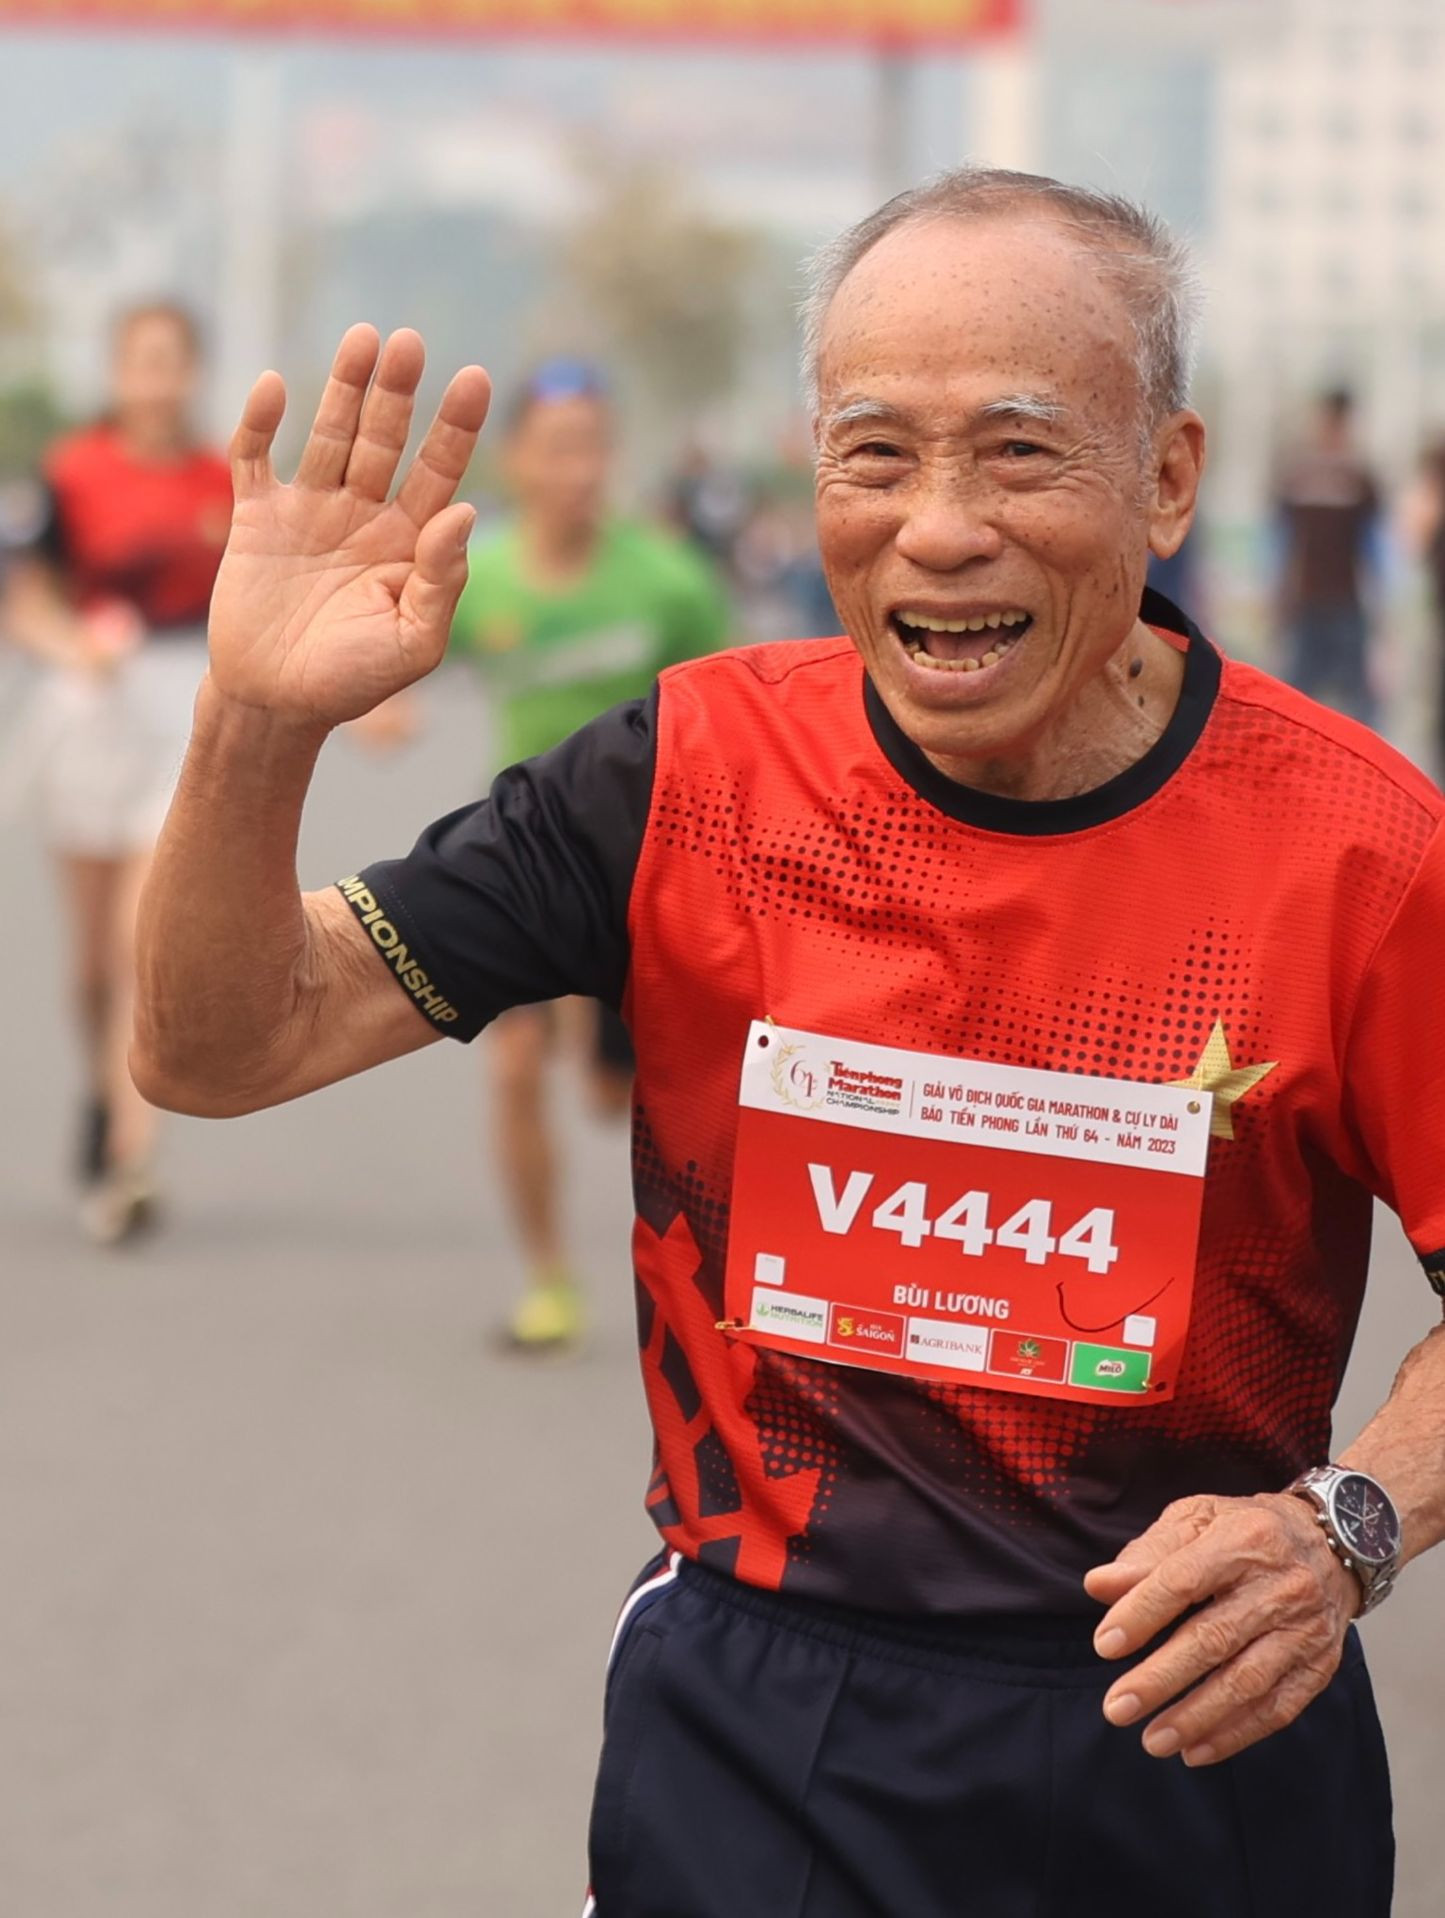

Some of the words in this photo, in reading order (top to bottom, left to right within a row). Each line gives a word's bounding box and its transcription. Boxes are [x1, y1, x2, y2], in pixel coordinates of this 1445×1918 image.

[826, 1090, 876, 1105] NATIONAL
[827, 1077, 902, 1101] Marathon
[826, 1097, 900, 1115] CHAMPIONSHIP
[923, 1080, 946, 1099] GIẢI
[948, 1083, 964, 1102] VÕ
[966, 1088, 993, 1108] ĐỊCH
[995, 1091, 1025, 1110] QUỐC
[1026, 1097, 1046, 1112] GIA
[1048, 1100, 1110, 1122] MARATHON
[1111, 1108, 1122, 1123] &
[1124, 1110, 1142, 1130] CỰ
[1143, 1112, 1158, 1128] LY
[1159, 1112, 1180, 1131] DÀI
[920, 1104, 943, 1123] BÁO
[981, 1114, 1020, 1133] PHONG
[1055, 1123, 1079, 1141] THỨ
[1083, 1128, 1099, 1144] 64
[1116, 1131, 1142, 1150] NĂM
[1147, 1137, 1177, 1155] 2023
[807, 1162, 1119, 1275] V4444
[892, 1282, 930, 1309] BÙI
[933, 1290, 1010, 1320] LƯƠNG
[770, 1304, 824, 1321] HERBALIFE
[919, 1336, 984, 1355] AGRIBANK
[1098, 1364, 1122, 1374] MILO
